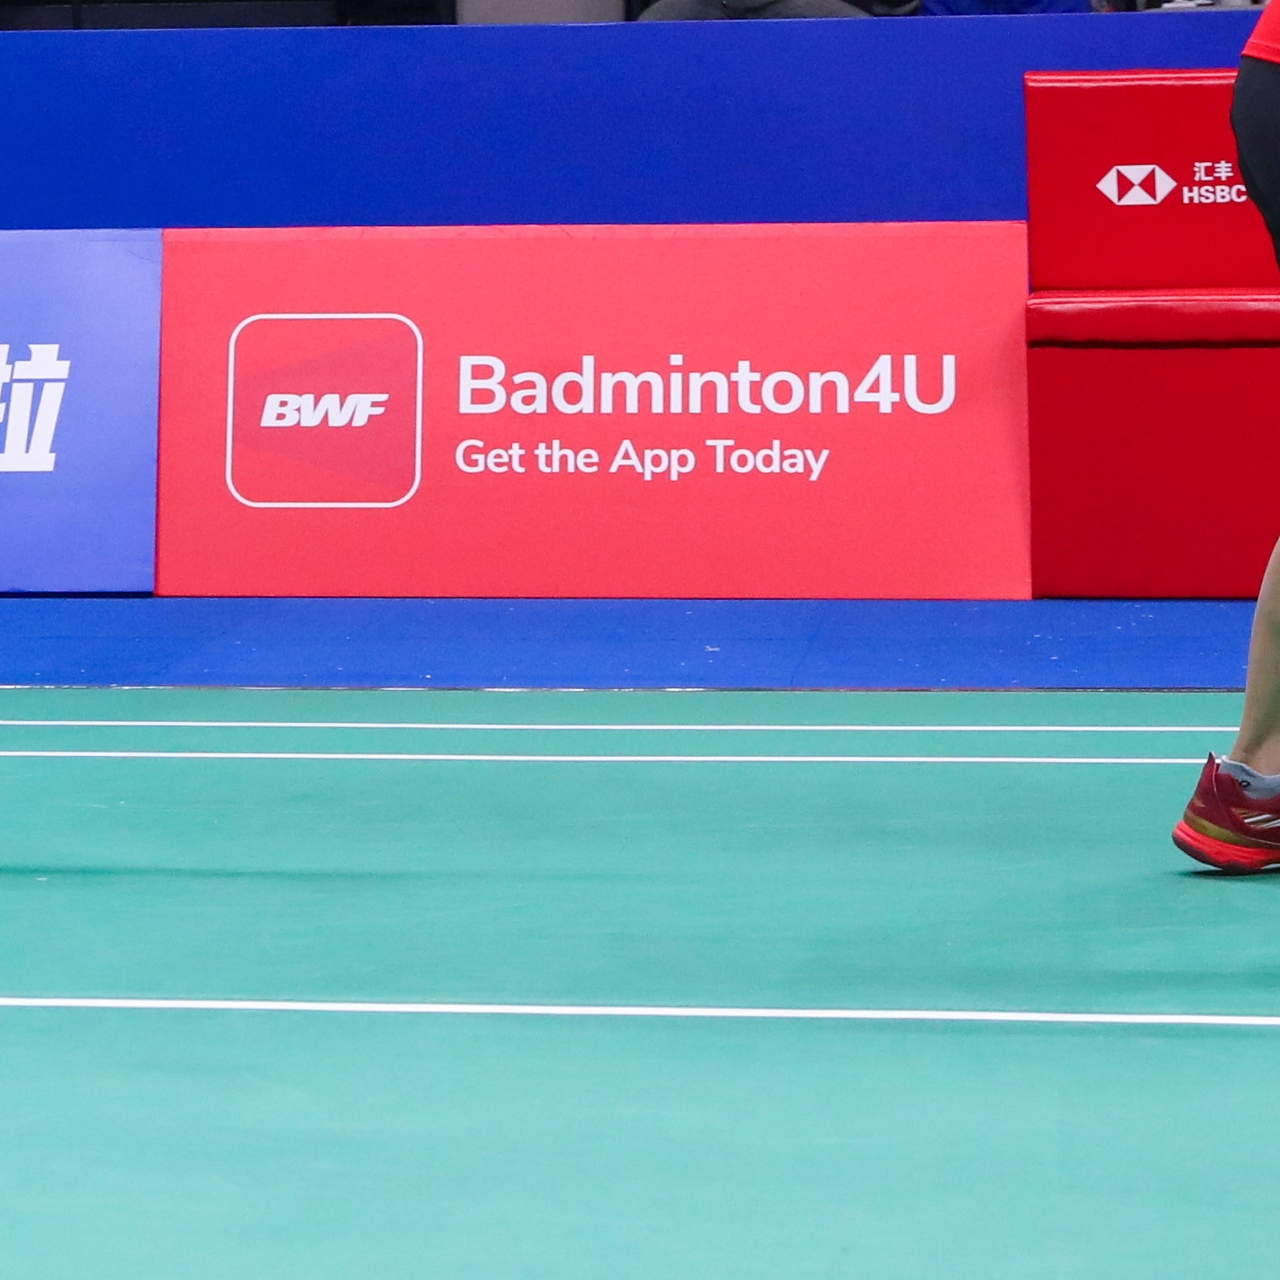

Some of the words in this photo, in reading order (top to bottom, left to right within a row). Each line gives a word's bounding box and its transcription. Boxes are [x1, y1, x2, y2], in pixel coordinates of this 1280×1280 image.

[1193, 160, 1234, 181] 汇丰
[1182, 184, 1248, 204] HSBC
[458, 354, 957, 415] Badminton4U
[260, 393, 389, 428] BWF
[455, 440, 527, 474] Get
[534, 438, 599, 474] the
[609, 440, 696, 481] App
[705, 439, 830, 482] Today
